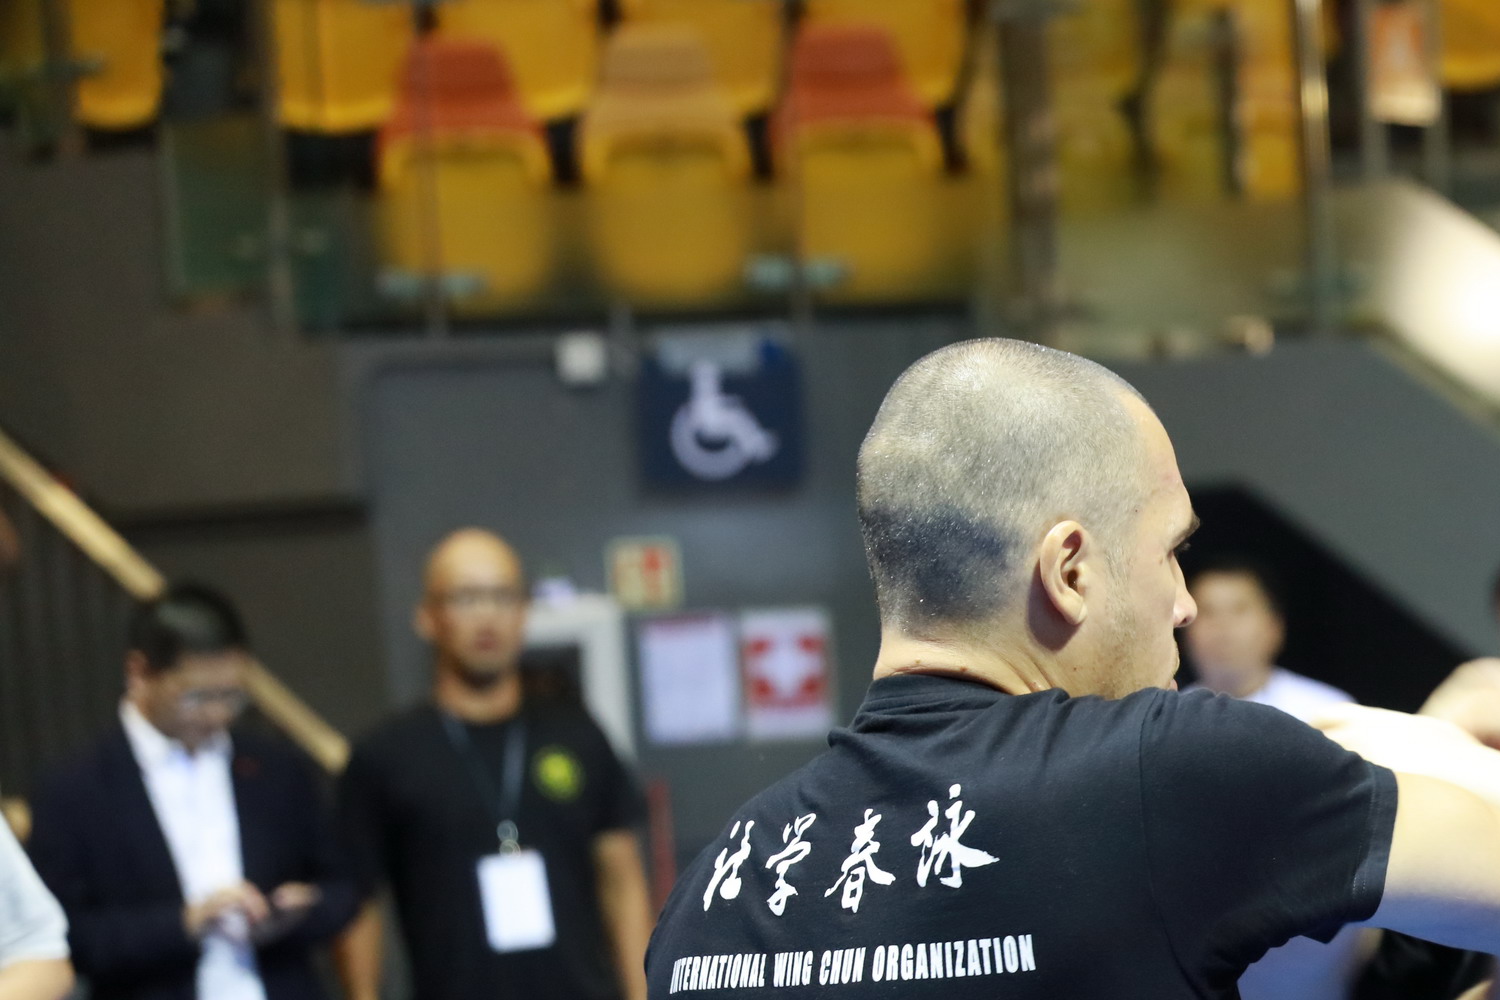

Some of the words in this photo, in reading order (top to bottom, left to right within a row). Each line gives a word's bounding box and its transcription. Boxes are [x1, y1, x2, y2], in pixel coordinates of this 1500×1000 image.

[669, 952, 767, 995] INTERNATIONAL
[773, 950, 814, 988] WING
[819, 946, 868, 986] CHUN
[871, 933, 1037, 983] ORGANIZATION
